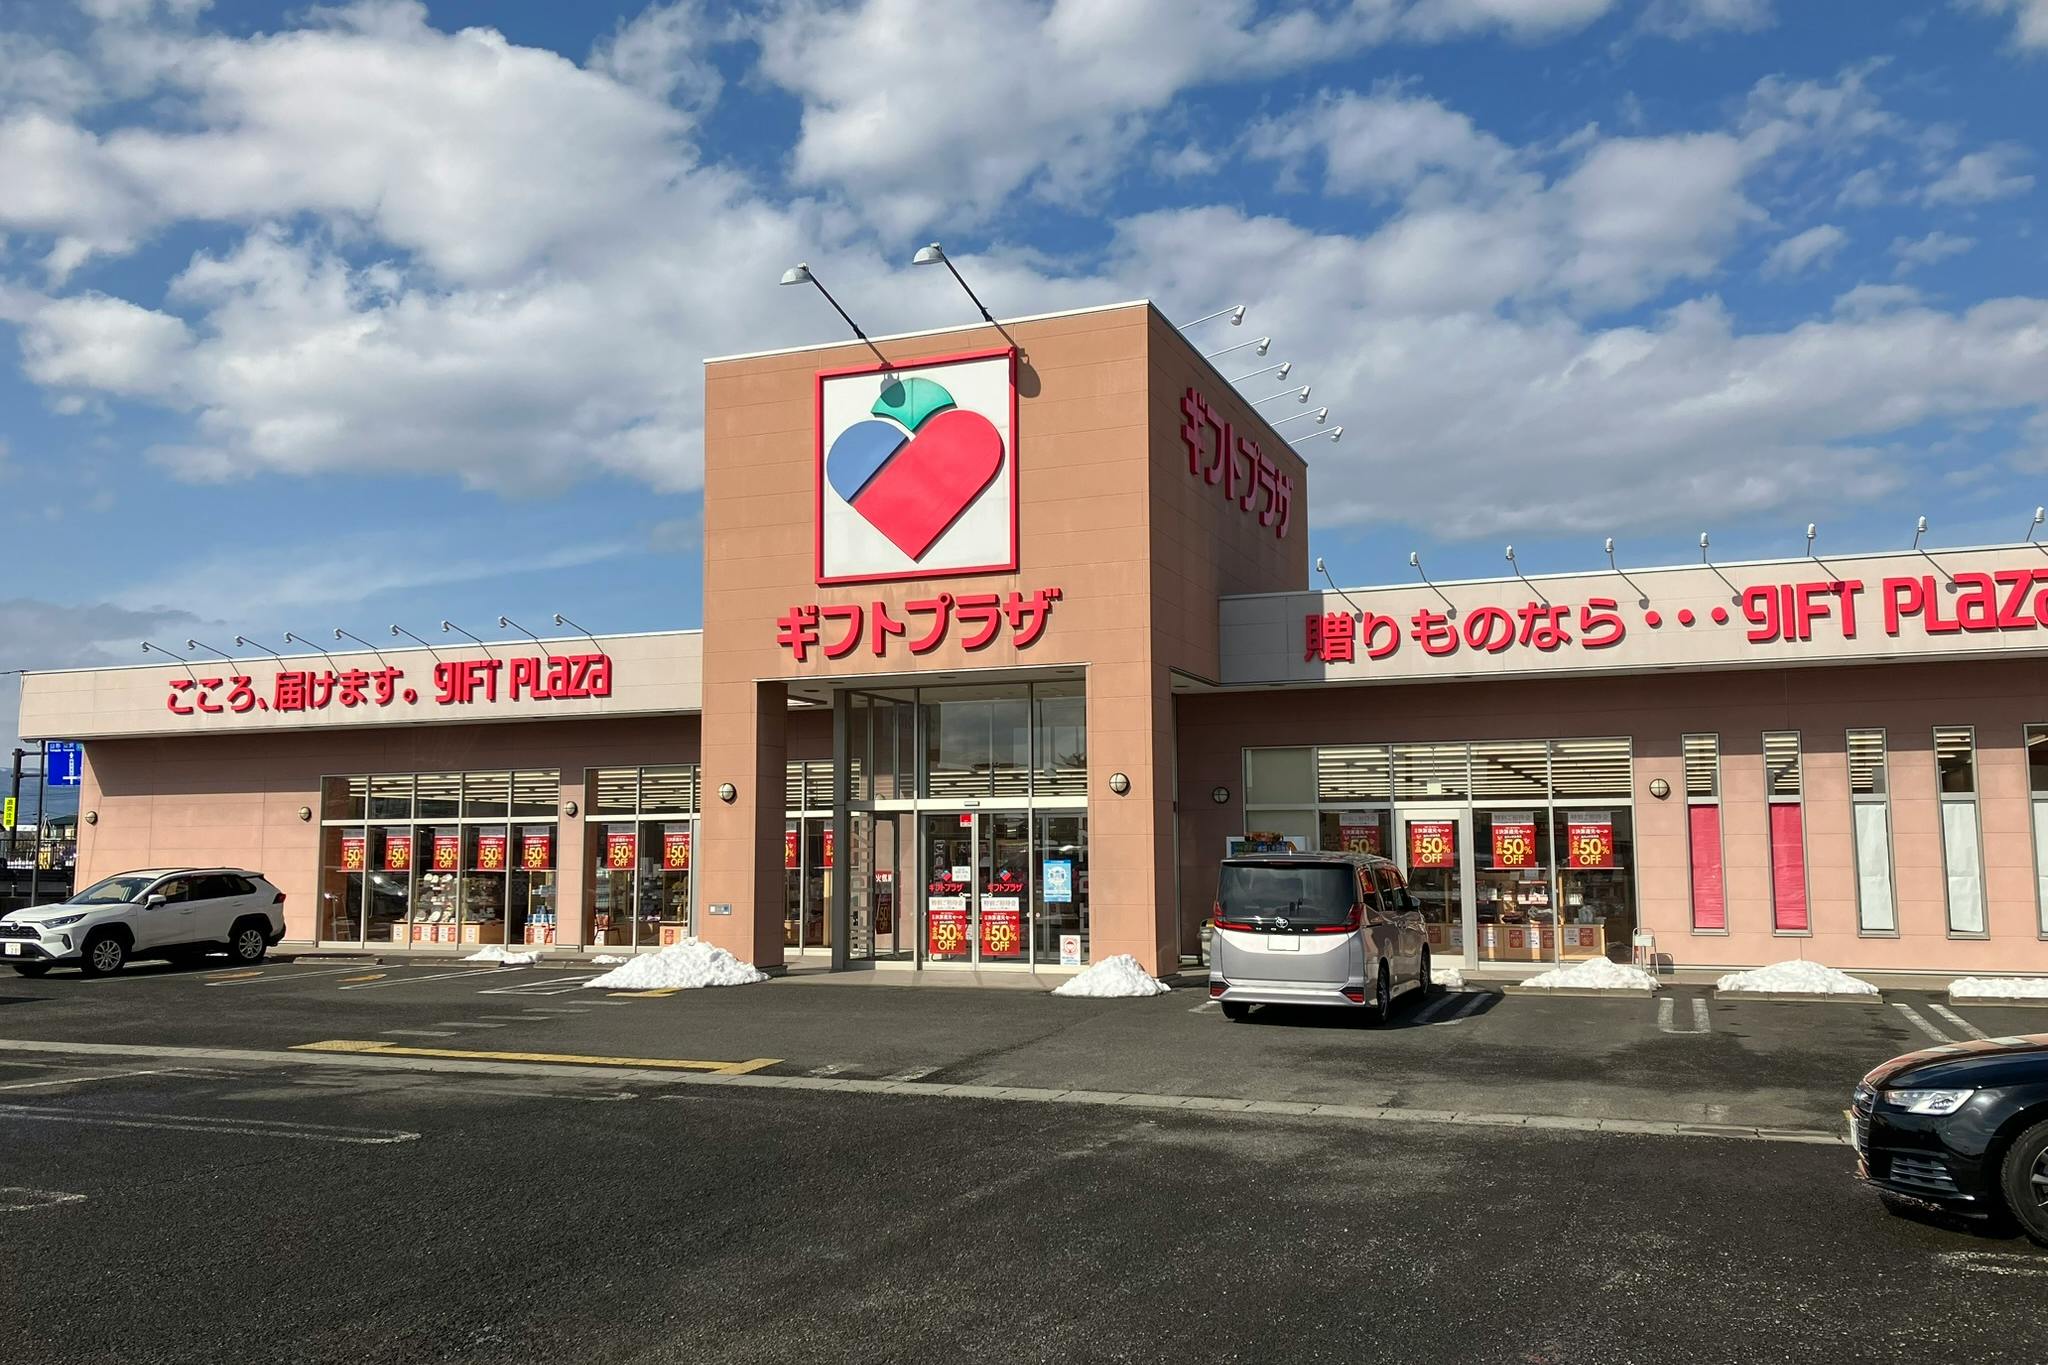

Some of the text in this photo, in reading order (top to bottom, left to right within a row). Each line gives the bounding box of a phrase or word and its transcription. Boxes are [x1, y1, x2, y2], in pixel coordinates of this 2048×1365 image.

[1181, 387, 1293, 539] ギフトプラザ
[777, 588, 1062, 661] ギフトプラザ
[1422, 853, 1442, 863] OFF
[1503, 855, 1524, 864] OFF
[1580, 855, 1601, 865] OFF
[938, 941, 956, 950] OFF
[991, 941, 1010, 951] OFF
